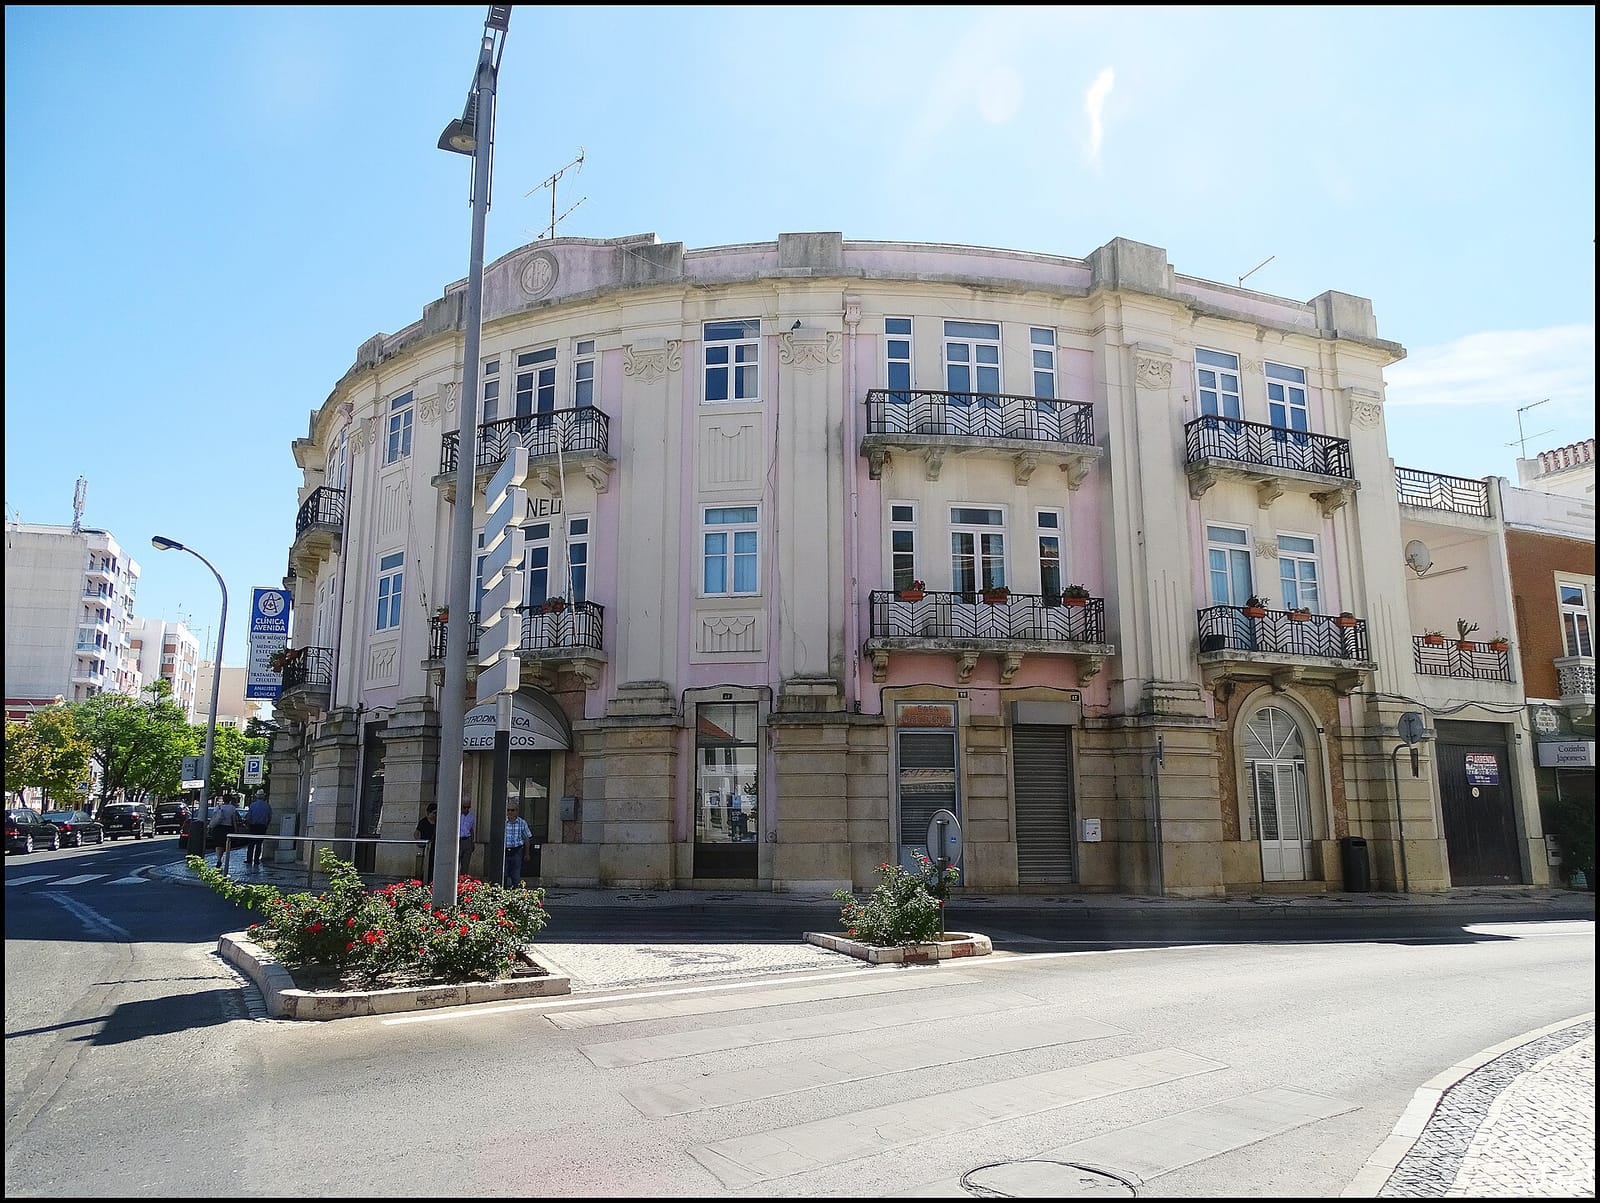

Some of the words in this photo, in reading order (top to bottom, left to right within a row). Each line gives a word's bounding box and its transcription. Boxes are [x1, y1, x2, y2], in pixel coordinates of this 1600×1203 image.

[253, 624, 286, 632] AVENIDA
[1558, 744, 1586, 753] Cozinha
[1556, 753, 1587, 764] Japonesa
[249, 761, 258, 772] P
